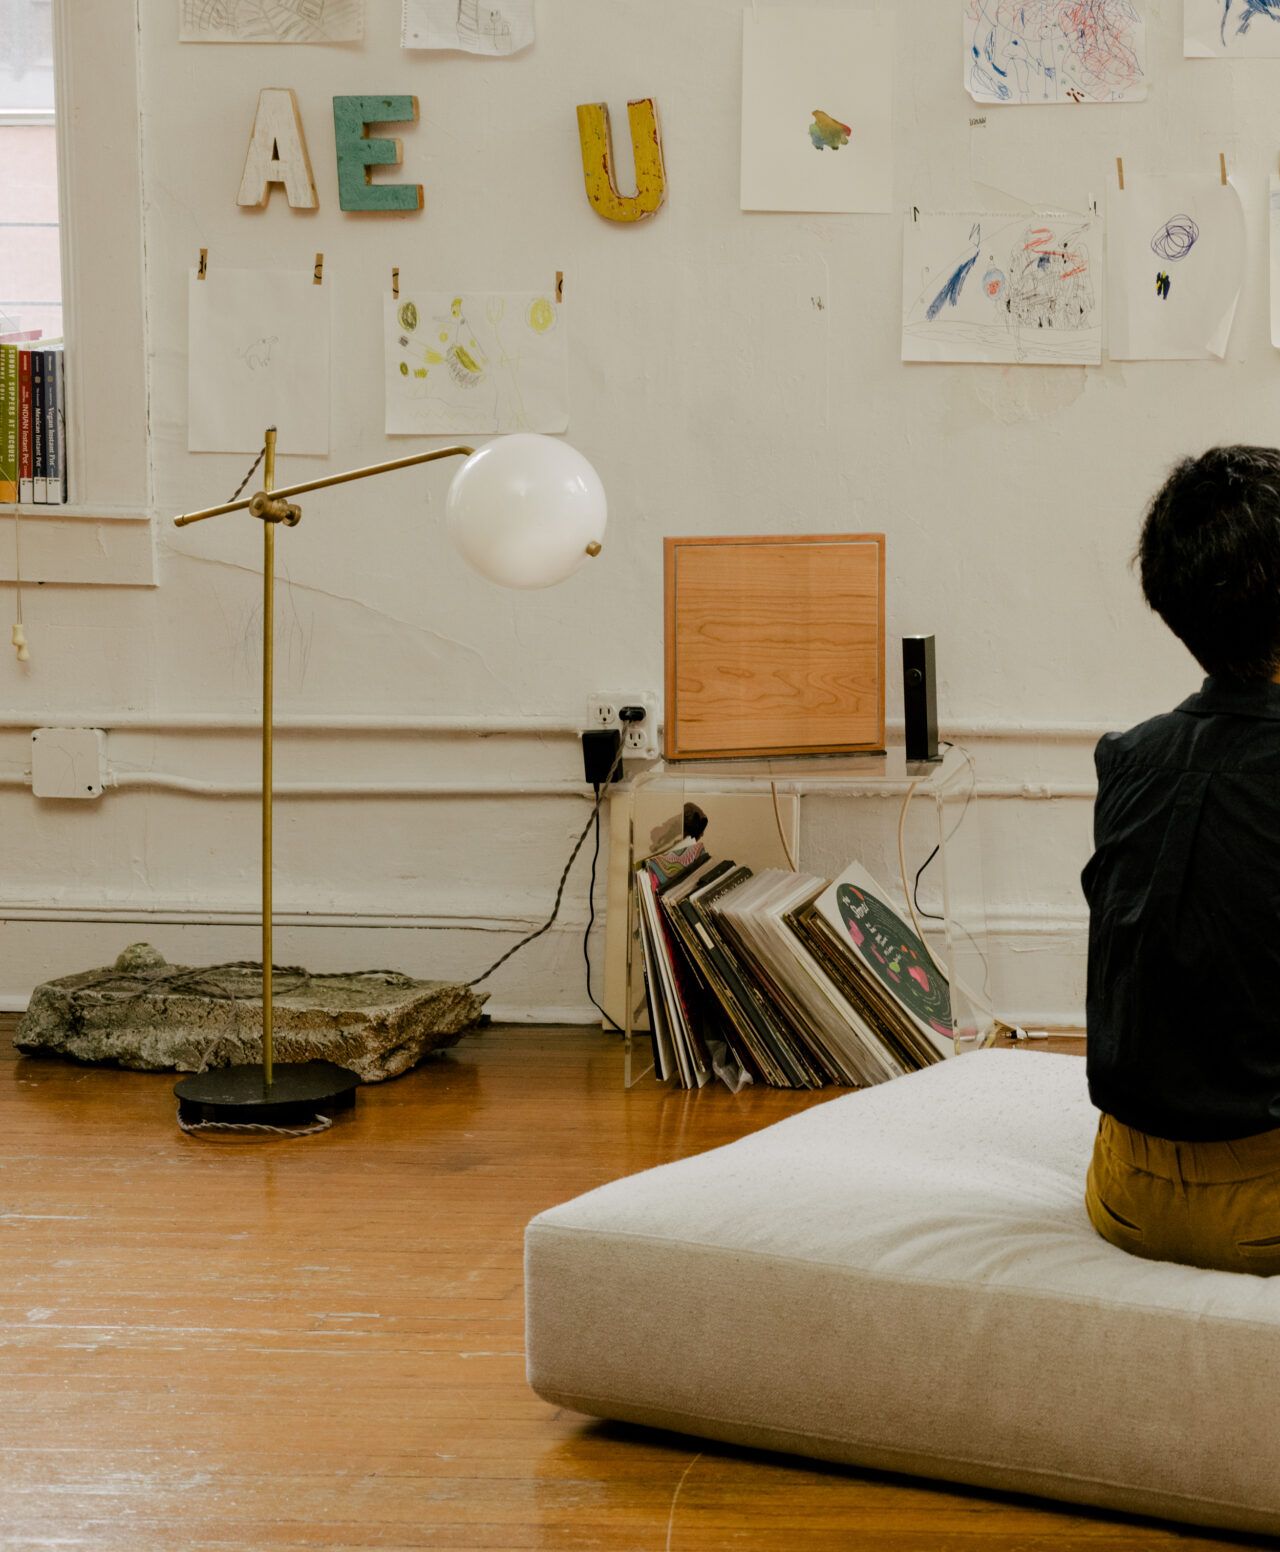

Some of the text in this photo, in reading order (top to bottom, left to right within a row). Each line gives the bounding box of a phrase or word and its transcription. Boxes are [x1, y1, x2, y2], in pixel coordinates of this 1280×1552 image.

[577, 97, 667, 222] U
[8, 349, 16, 378] SUNDAY
[8, 381, 16, 416] SUPPERS
[8, 418, 15, 428] AT
[47, 407, 55, 430] Vegan
